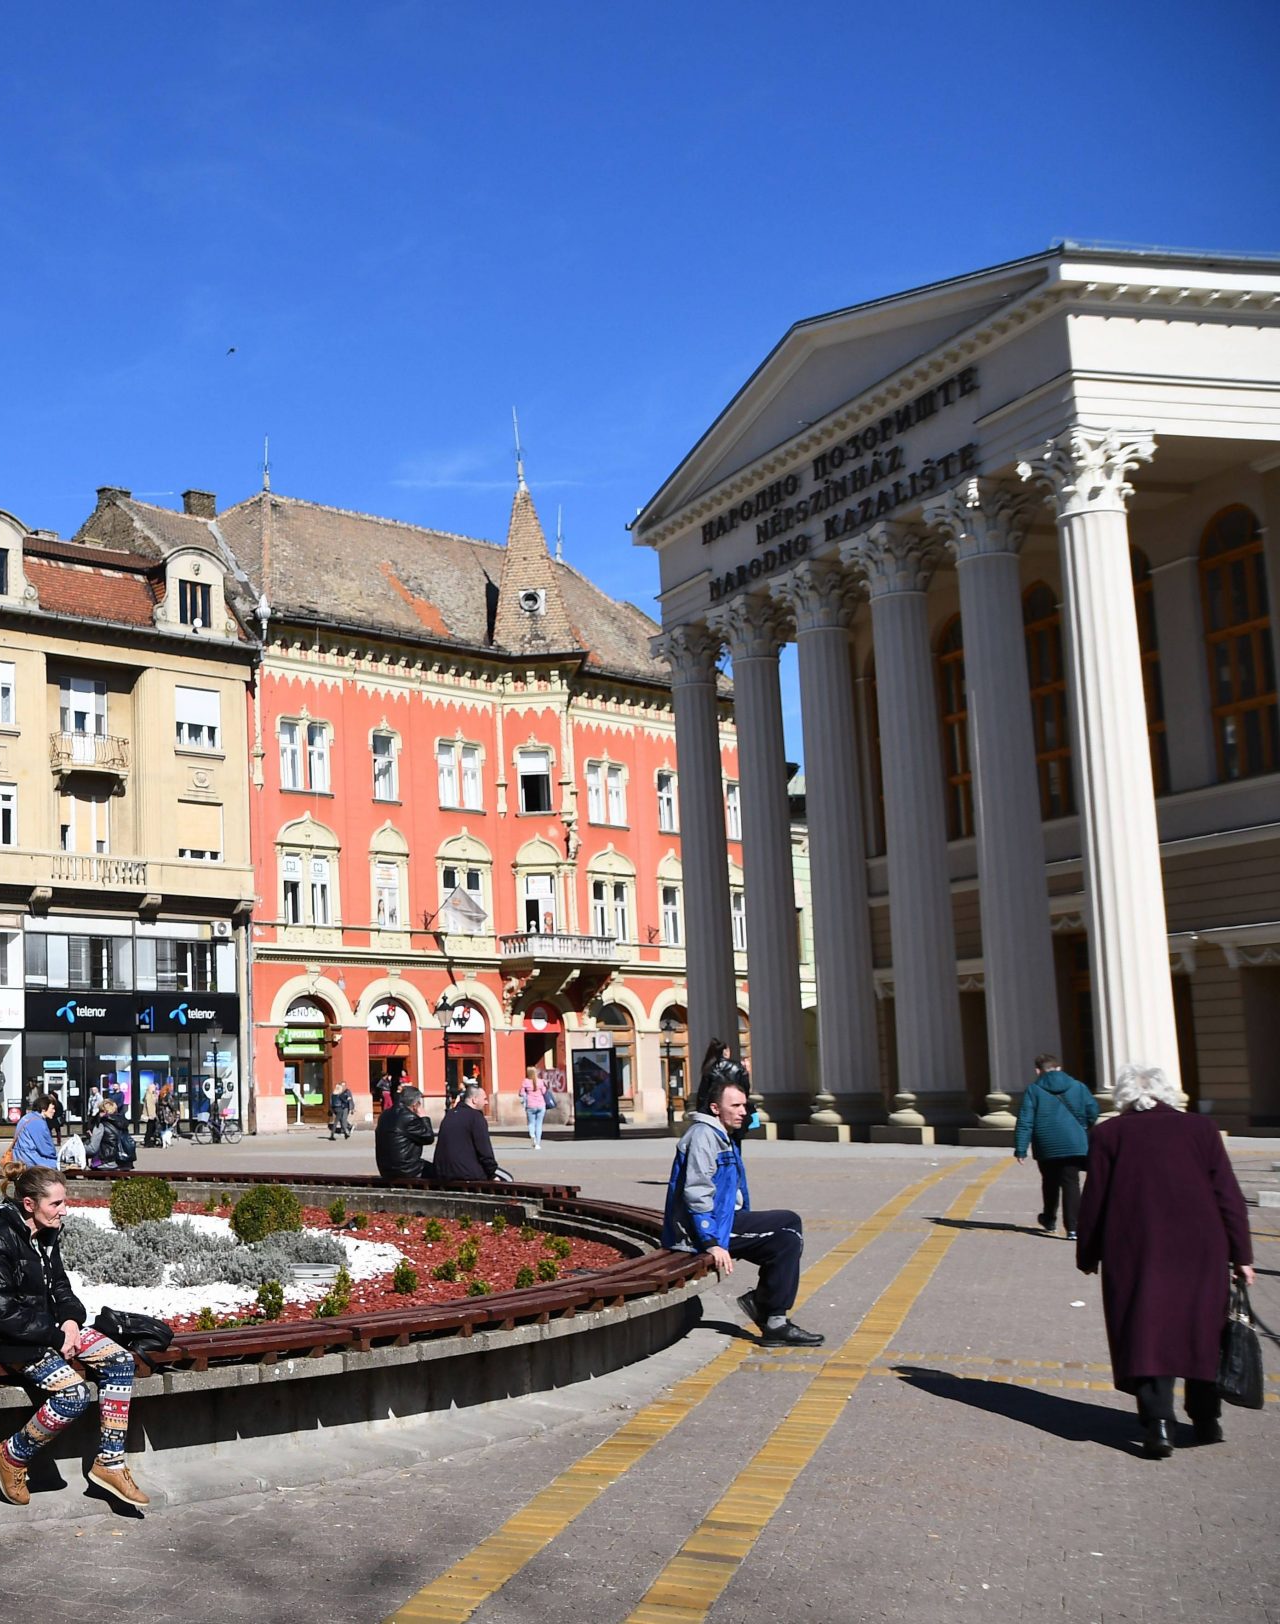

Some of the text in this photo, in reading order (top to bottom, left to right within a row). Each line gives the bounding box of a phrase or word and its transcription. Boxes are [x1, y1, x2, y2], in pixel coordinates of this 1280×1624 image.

[701, 366, 980, 546] НАРОДНО ПОЗОРИШТЕ
[756, 446, 906, 545] NÉPSZÍNHÁZ
[709, 443, 982, 602] NARODNO KAZALIŠTE
[76, 1005, 108, 1018] telenor
[187, 1008, 216, 1020] telenor
